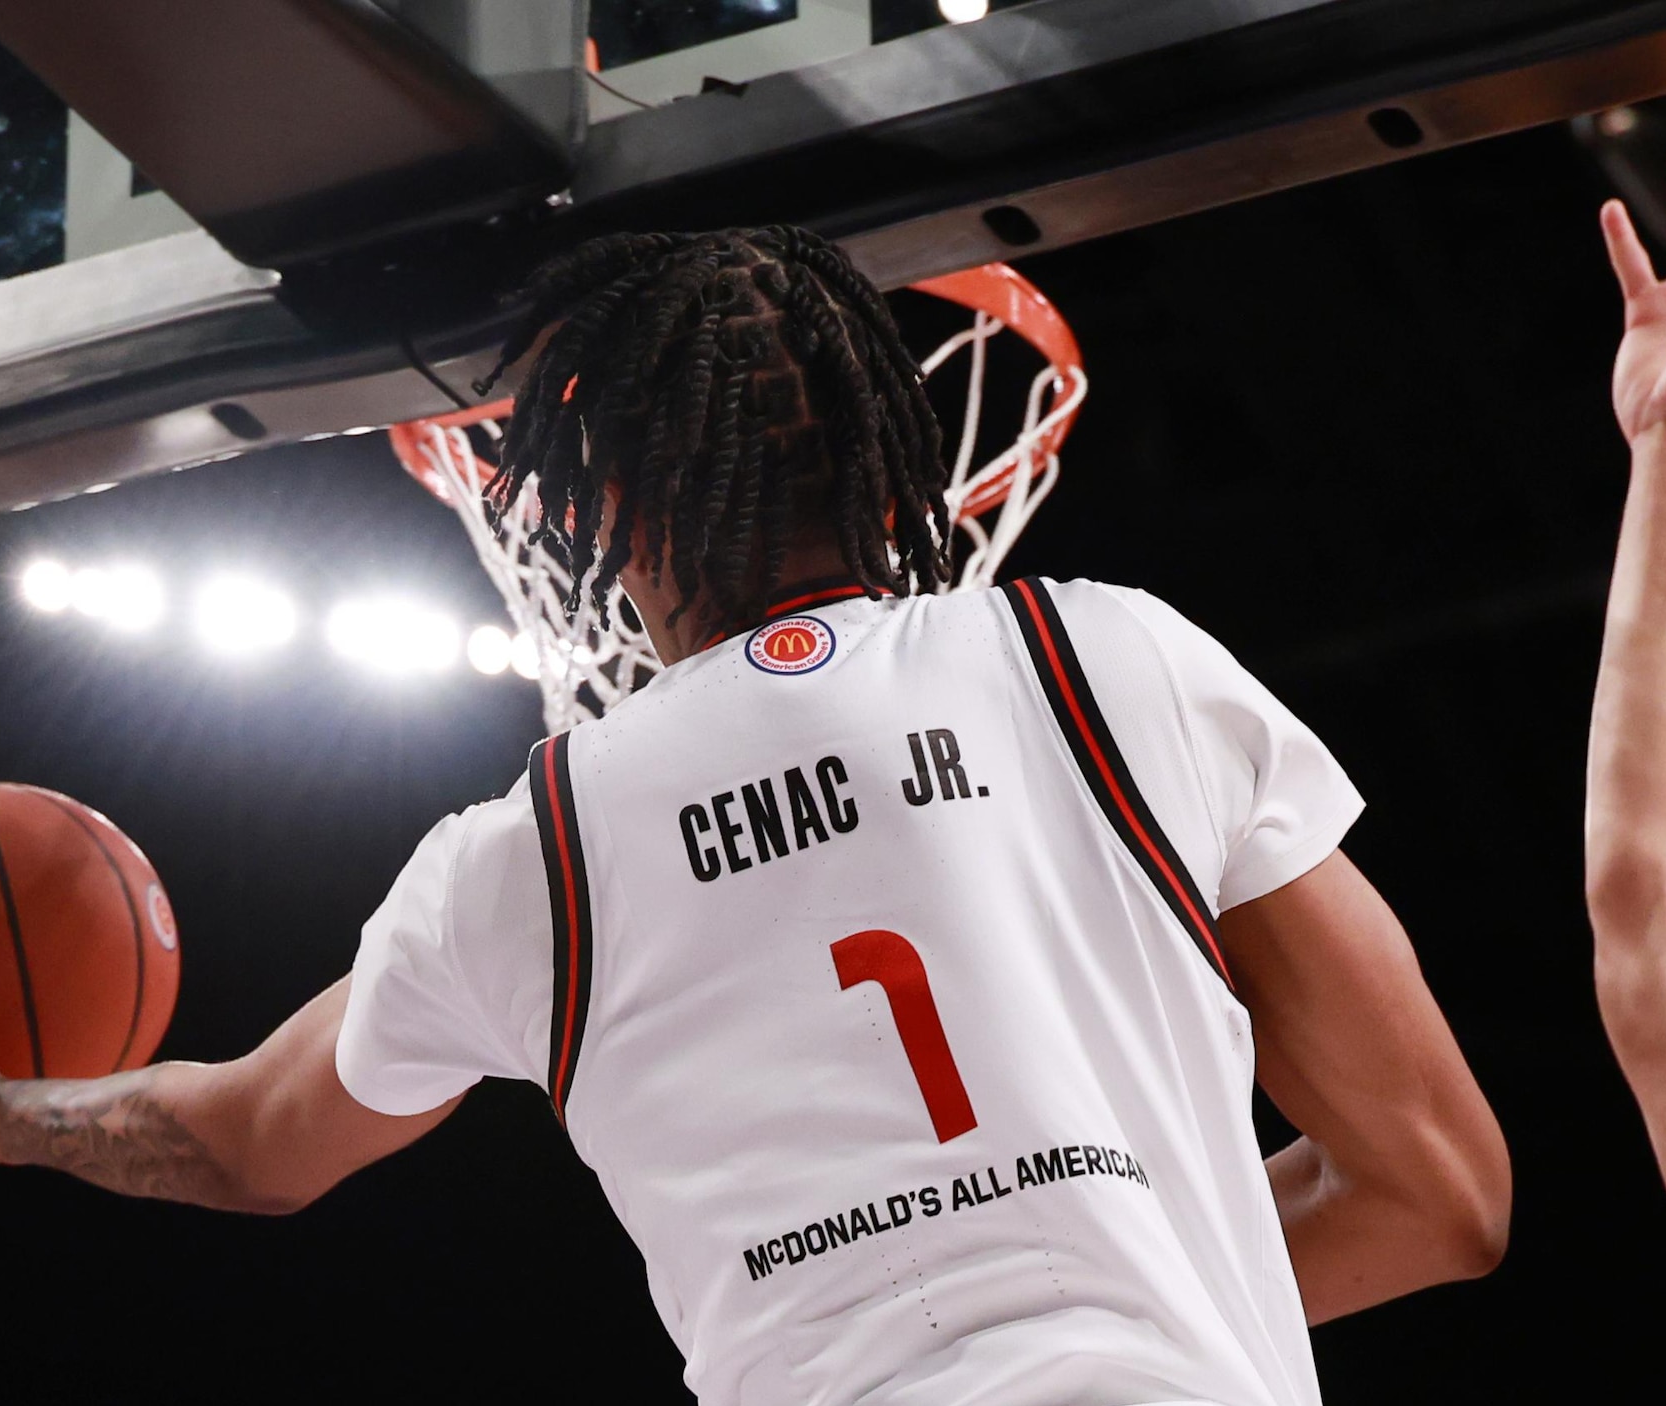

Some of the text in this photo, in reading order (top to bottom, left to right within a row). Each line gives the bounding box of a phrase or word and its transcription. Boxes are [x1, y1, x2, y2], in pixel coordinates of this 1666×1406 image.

[757, 619, 818, 638] McDonald's
[759, 657, 807, 670] American
[807, 641, 829, 664] Games
[679, 728, 990, 882] CENAC JR.
[829, 929, 978, 1145] 1
[951, 1166, 1012, 1212] ALL
